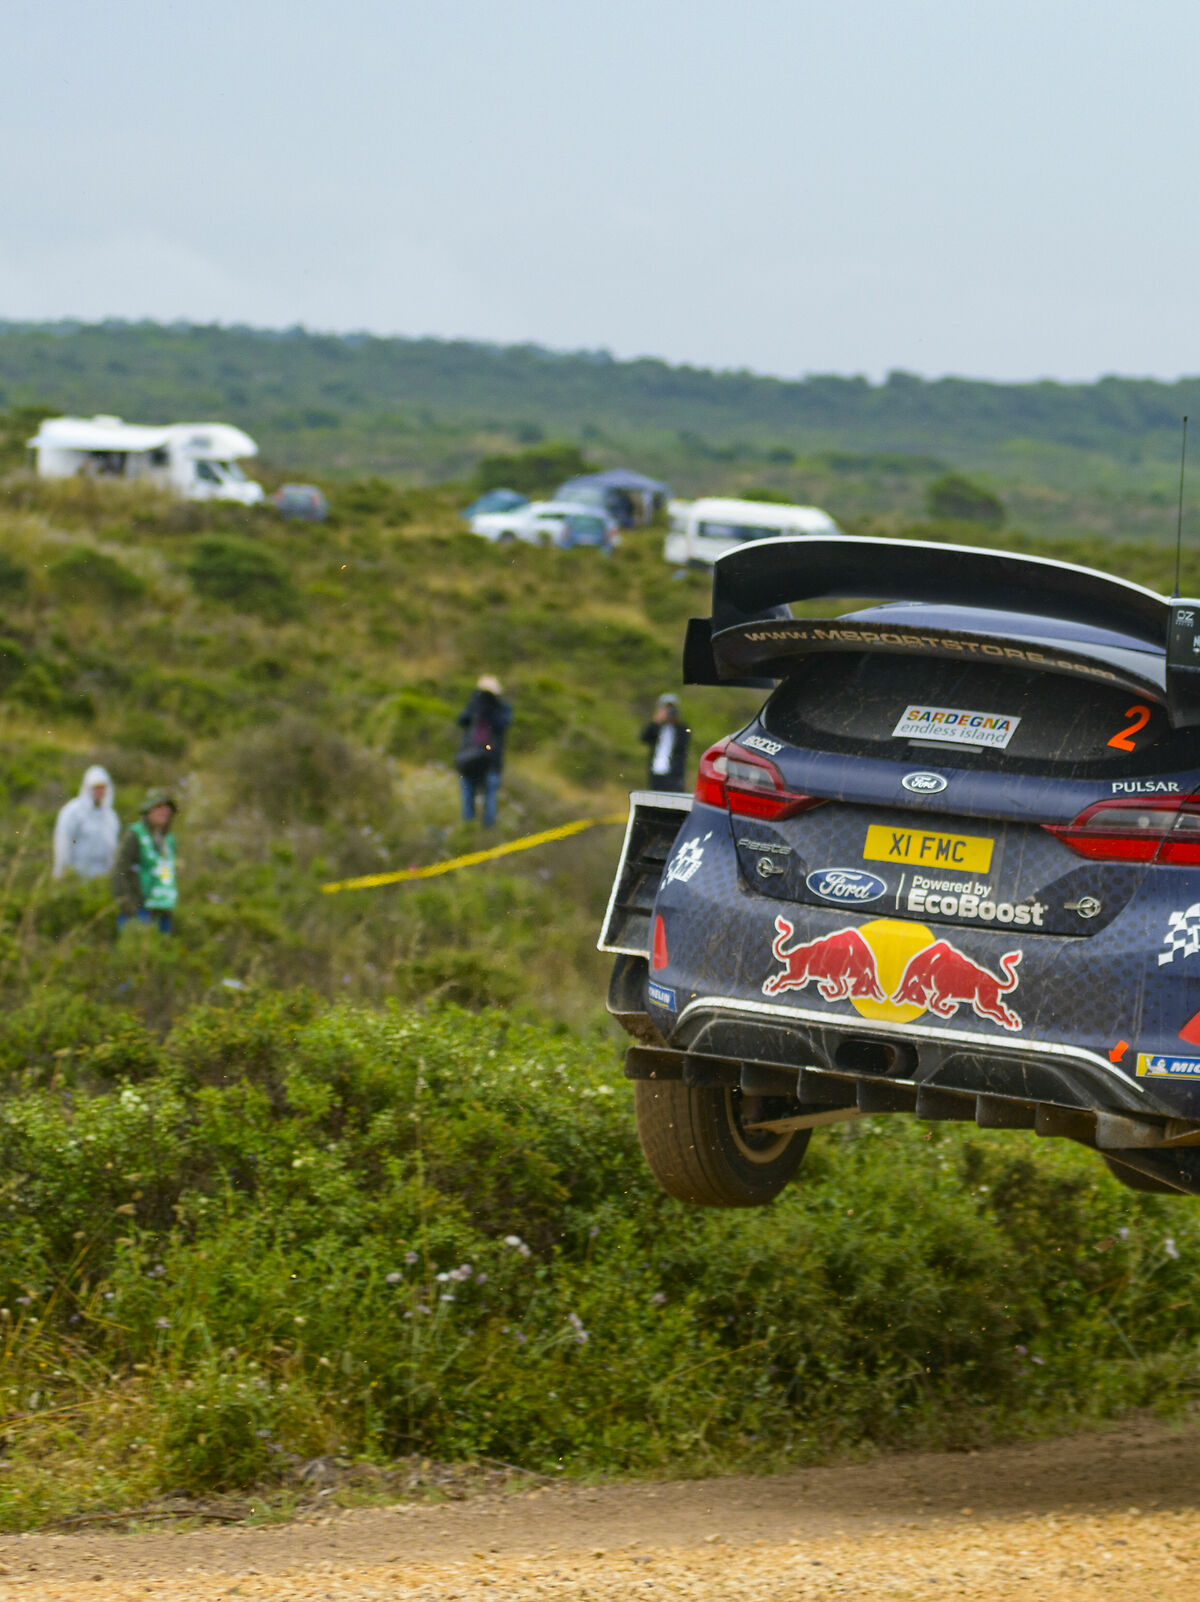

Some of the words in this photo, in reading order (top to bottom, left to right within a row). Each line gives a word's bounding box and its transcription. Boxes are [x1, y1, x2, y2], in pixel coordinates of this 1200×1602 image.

[1177, 610, 1195, 621] OZ
[744, 628, 1116, 681] www.MSPORTSTORE.com
[906, 710, 1012, 731] SARDEGNA
[1107, 705, 1150, 752] 2
[900, 722, 957, 738] endless
[959, 727, 1008, 744] island
[1112, 780, 1181, 794] PULSAR
[919, 838, 967, 863] FMC
[819, 871, 871, 900] Ford
[912, 875, 973, 895] Powered
[974, 881, 992, 899] by
[908, 889, 1044, 926] EcoBoost
